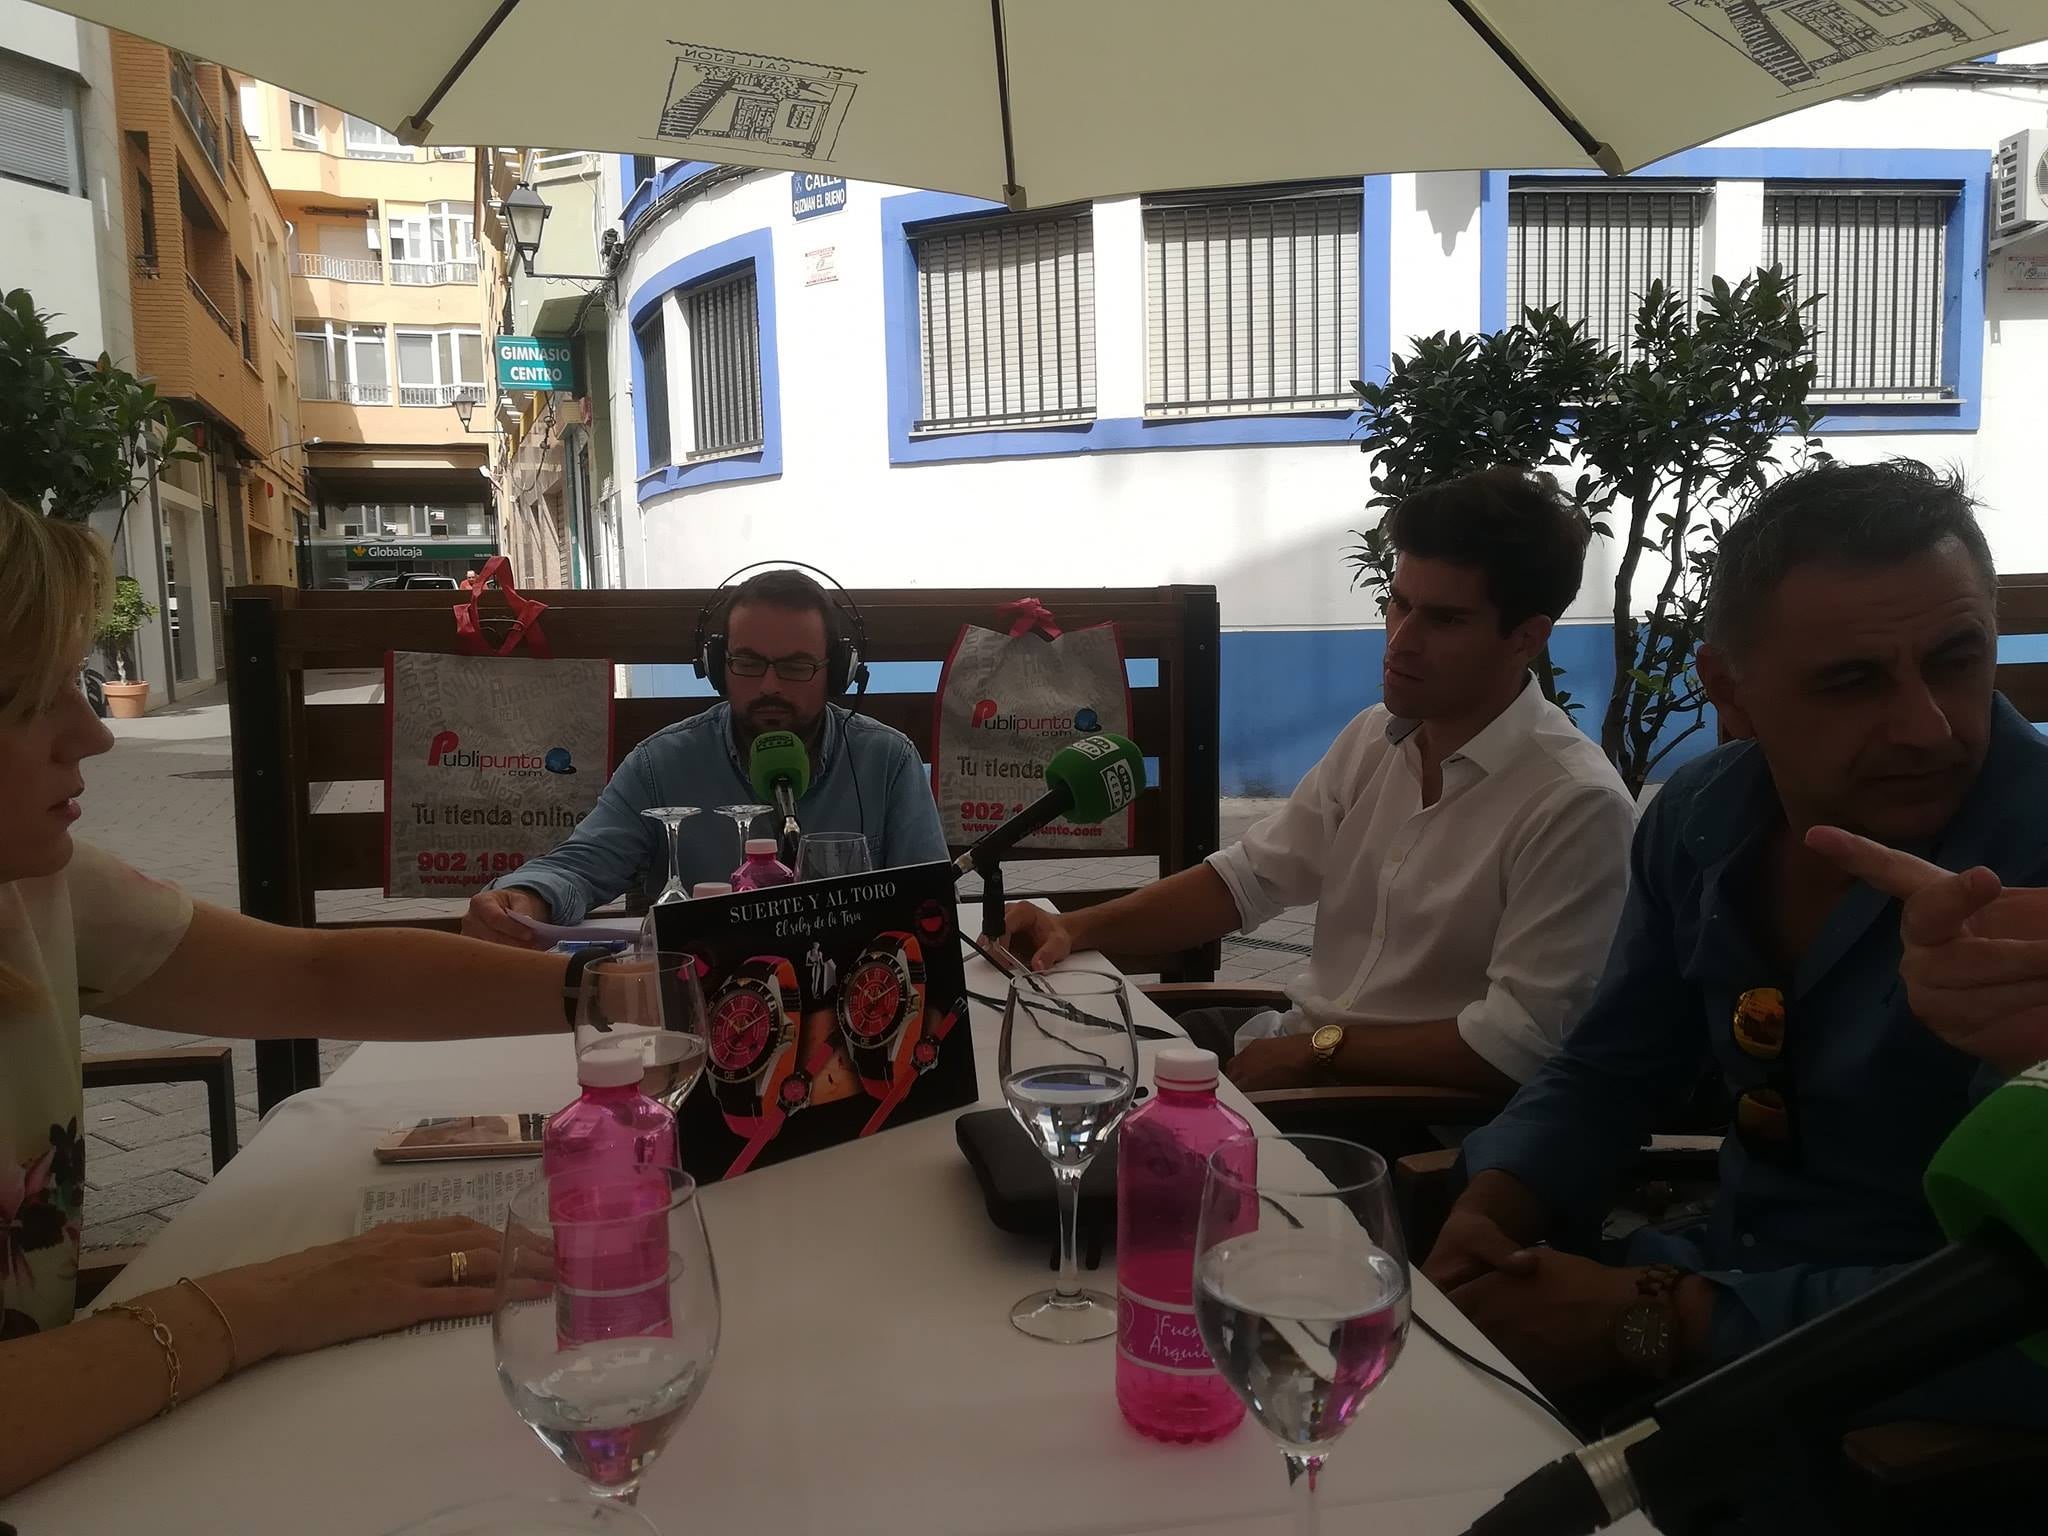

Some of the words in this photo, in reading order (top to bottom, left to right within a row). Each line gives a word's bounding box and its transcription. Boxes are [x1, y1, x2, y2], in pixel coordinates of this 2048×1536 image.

[792, 195, 816, 214] GUZMAN
[816, 193, 825, 209] EL
[824, 187, 846, 207] BUENO
[501, 346, 571, 361] GIMNASIO
[510, 366, 563, 381] CENTRO
[368, 546, 423, 559] Globalcaja
[970, 698, 1072, 736] Publipunto
[427, 729, 544, 772] Publipunto
[956, 756, 978, 777] Tu
[984, 757, 1044, 779] tienda
[1117, 765, 1132, 800] ONDA
[411, 801, 435, 825] Tu
[444, 803, 512, 826] tienda
[960, 801, 1004, 821] 902
[417, 851, 467, 872] 902
[729, 896, 804, 924] SUERTE
[808, 893, 821, 910] Y
[826, 889, 849, 908] AL
[849, 880, 897, 903] TORO
[776, 918, 789, 937] El
[813, 914, 825, 929] de
